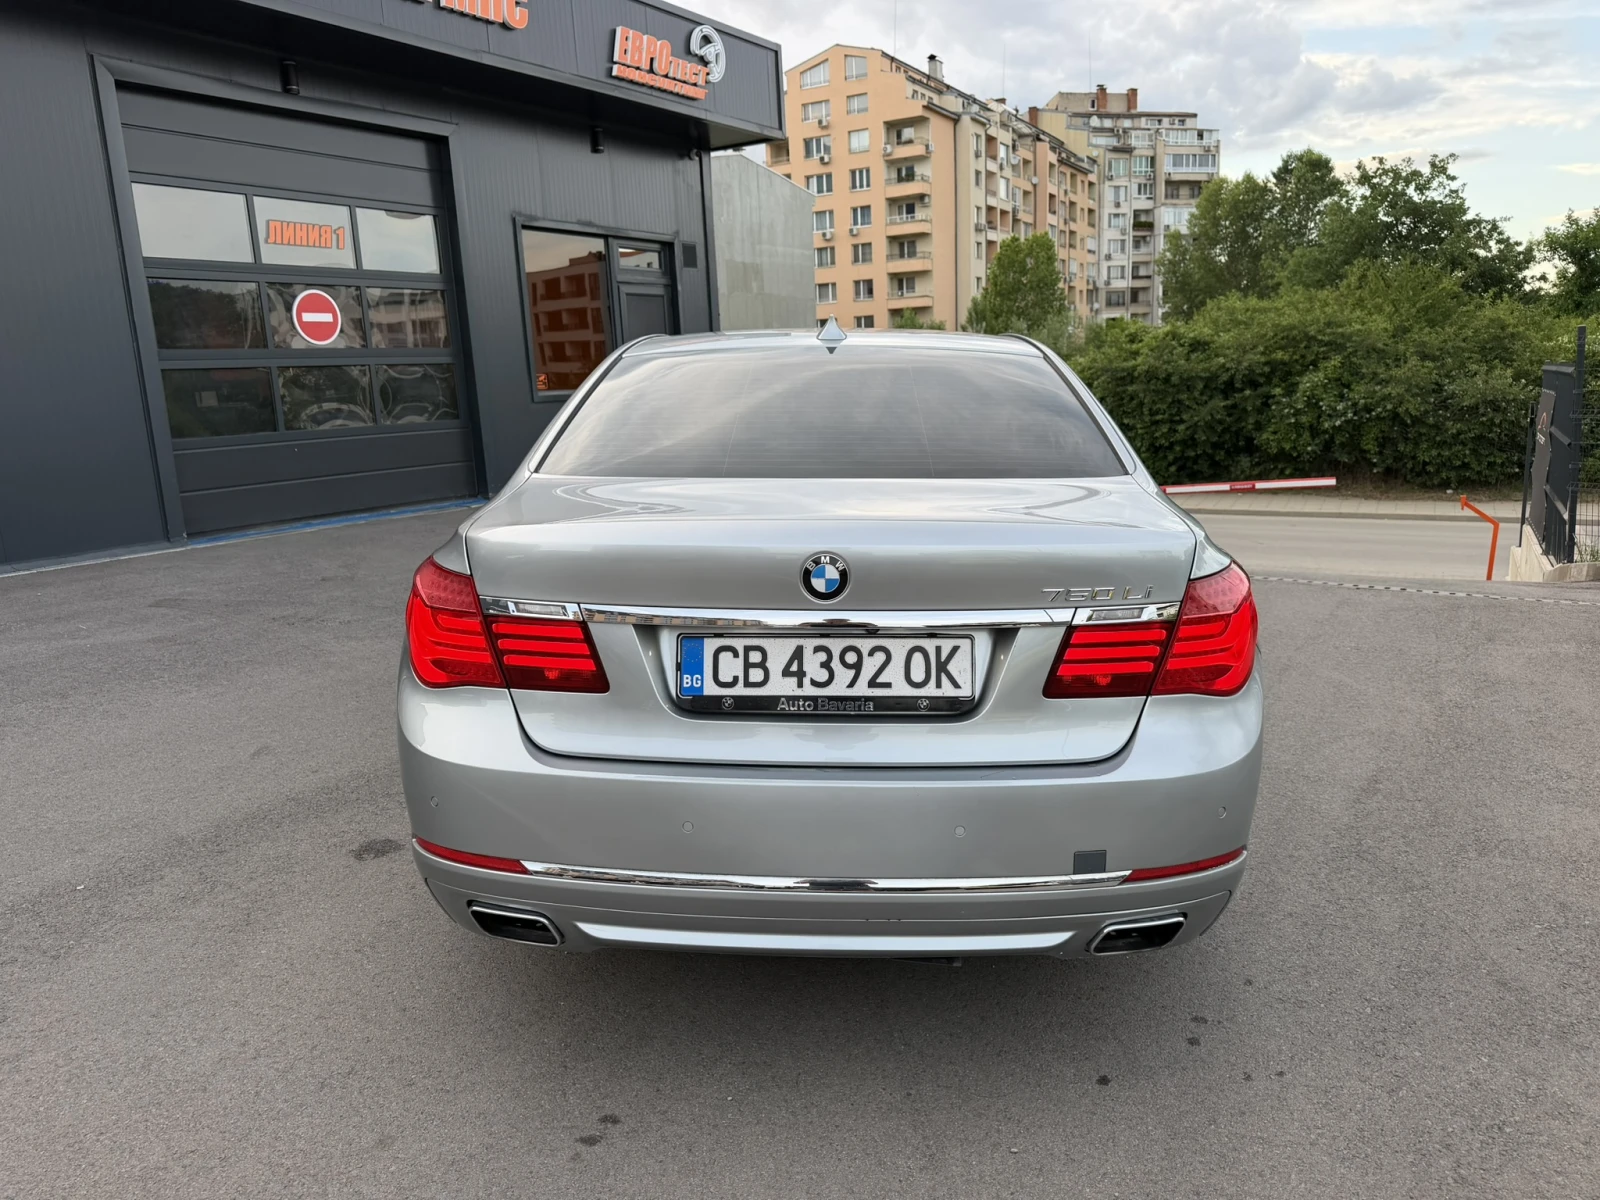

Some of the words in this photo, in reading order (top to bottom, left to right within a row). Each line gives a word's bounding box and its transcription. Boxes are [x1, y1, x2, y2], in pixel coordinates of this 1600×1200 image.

[265, 219, 333, 249] ЛИНИЯ
[334, 226, 345, 250] 1
[806, 555, 845, 571] BMW
[1042, 586, 1115, 602] 750
[1122, 584, 1154, 600] Li
[712, 644, 770, 689] CB
[781, 644, 893, 689] 4392
[904, 644, 962, 689] OK
[682, 674, 702, 688] BG
[777, 697, 814, 711] Auto
[817, 697, 874, 712] Bavaria
